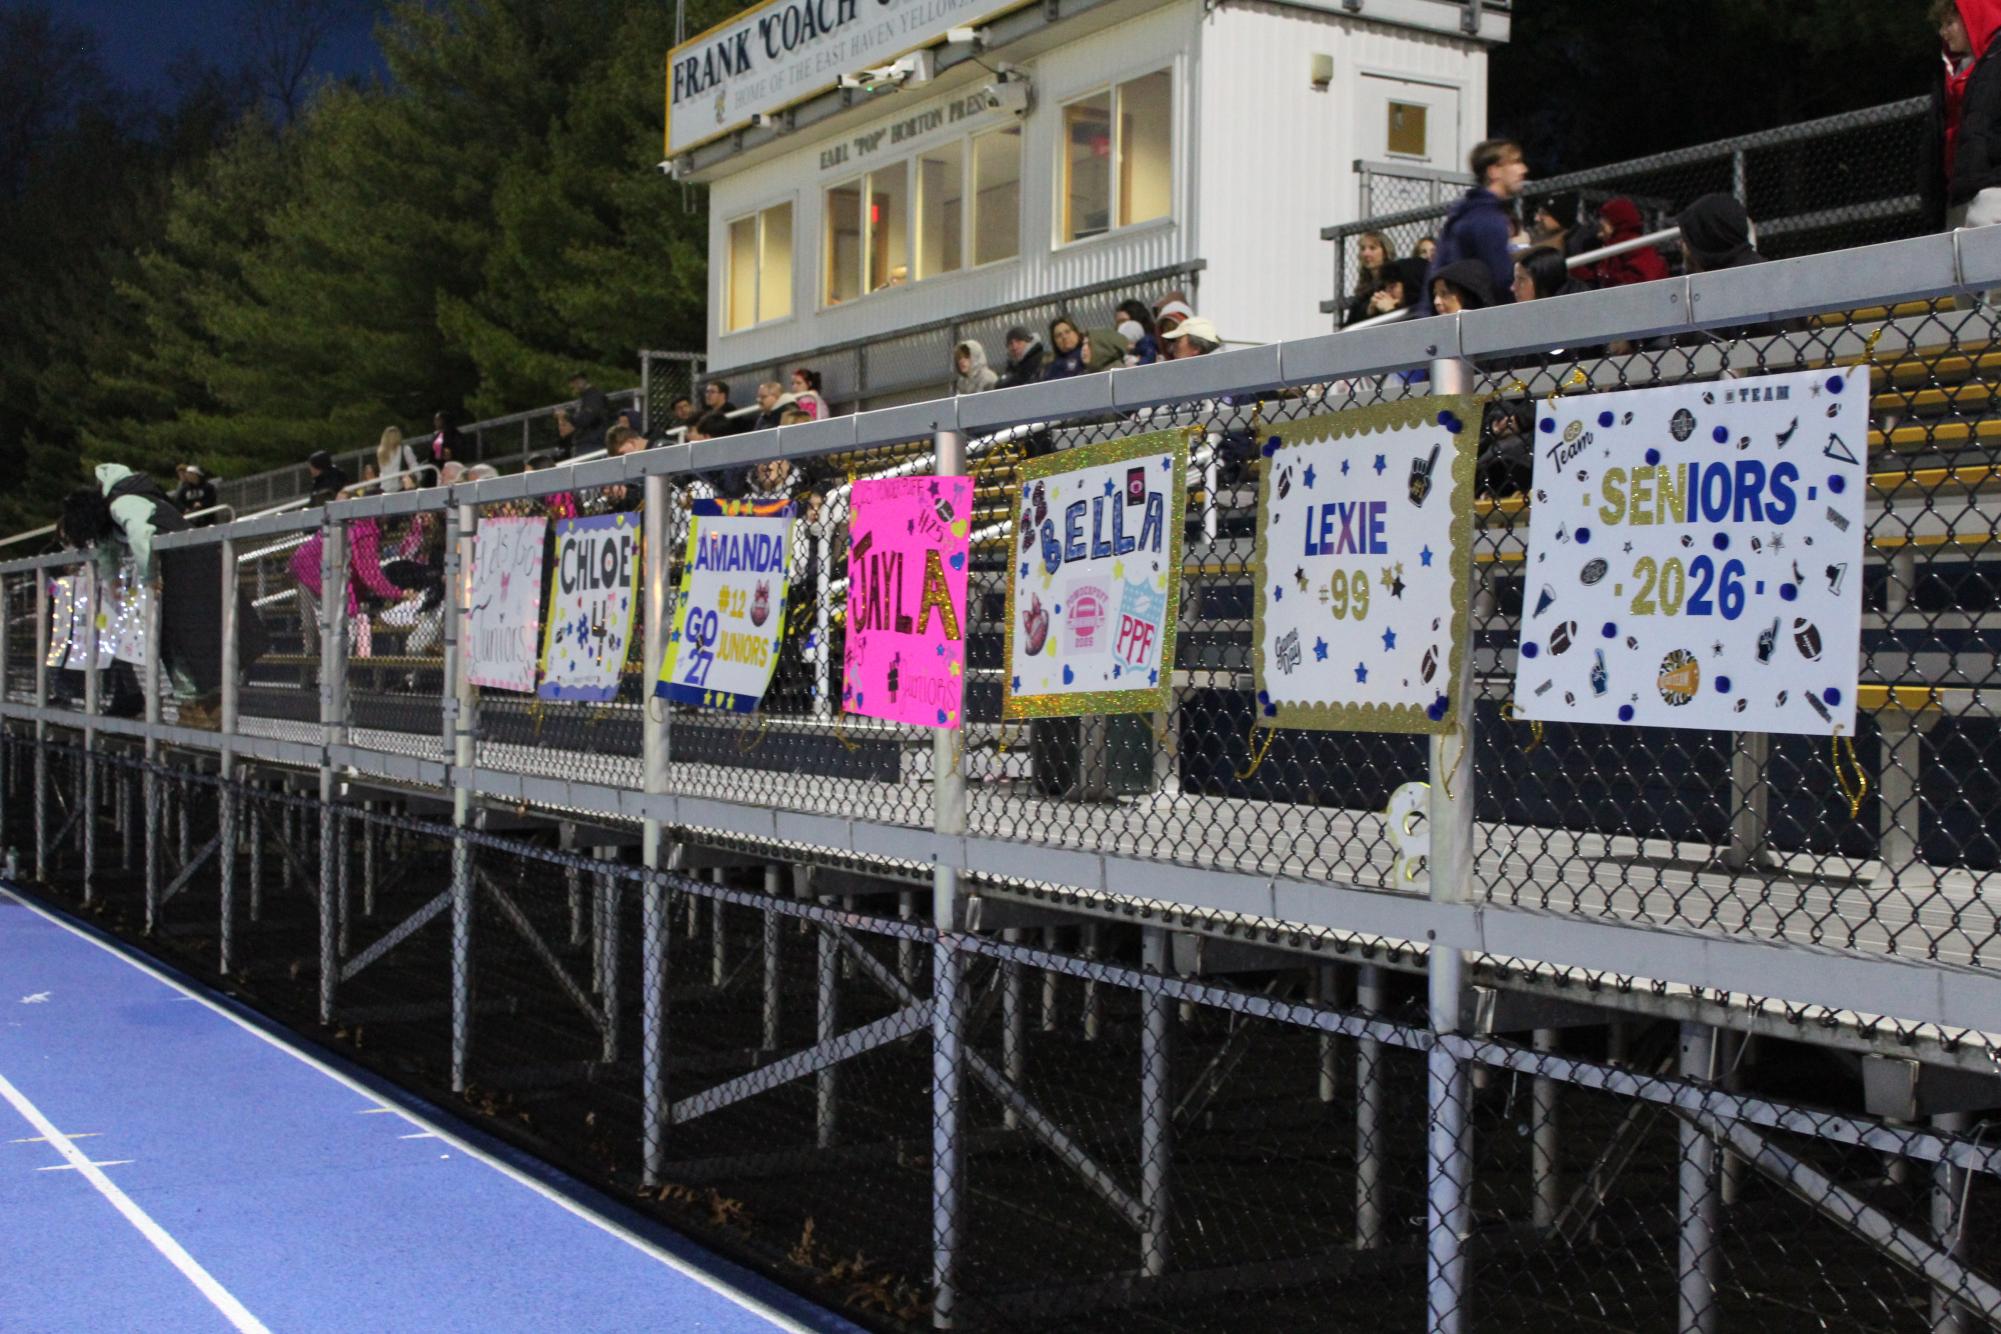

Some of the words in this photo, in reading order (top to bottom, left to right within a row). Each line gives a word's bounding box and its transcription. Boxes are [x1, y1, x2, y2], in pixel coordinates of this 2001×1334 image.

[673, 27, 752, 104] FRANK
[735, 81, 769, 110] HOME
[770, 70, 786, 94] OF
[789, 56, 813, 85] THE
[815, 41, 846, 72] EAST
[850, 20, 895, 57] HAVEN
[1739, 386, 1790, 403] TEAM
[1546, 431, 1594, 474] Team
[1598, 459, 1800, 526] SENIORS
[694, 531, 783, 574] AMANDA
[1040, 489, 1163, 575] BELLA
[1304, 500, 1388, 556] LEXIE
[560, 535, 631, 596] CHLOE
[852, 530, 962, 641] JAYLA
[1629, 554, 1746, 621] 2026
[717, 584, 747, 620] #12
[1318, 568, 1370, 621] #99
[685, 606, 718, 648] GO
[716, 629, 770, 669] JUNIORS
[1117, 613, 1155, 665] PPF
[683, 651, 714, 687] 27
